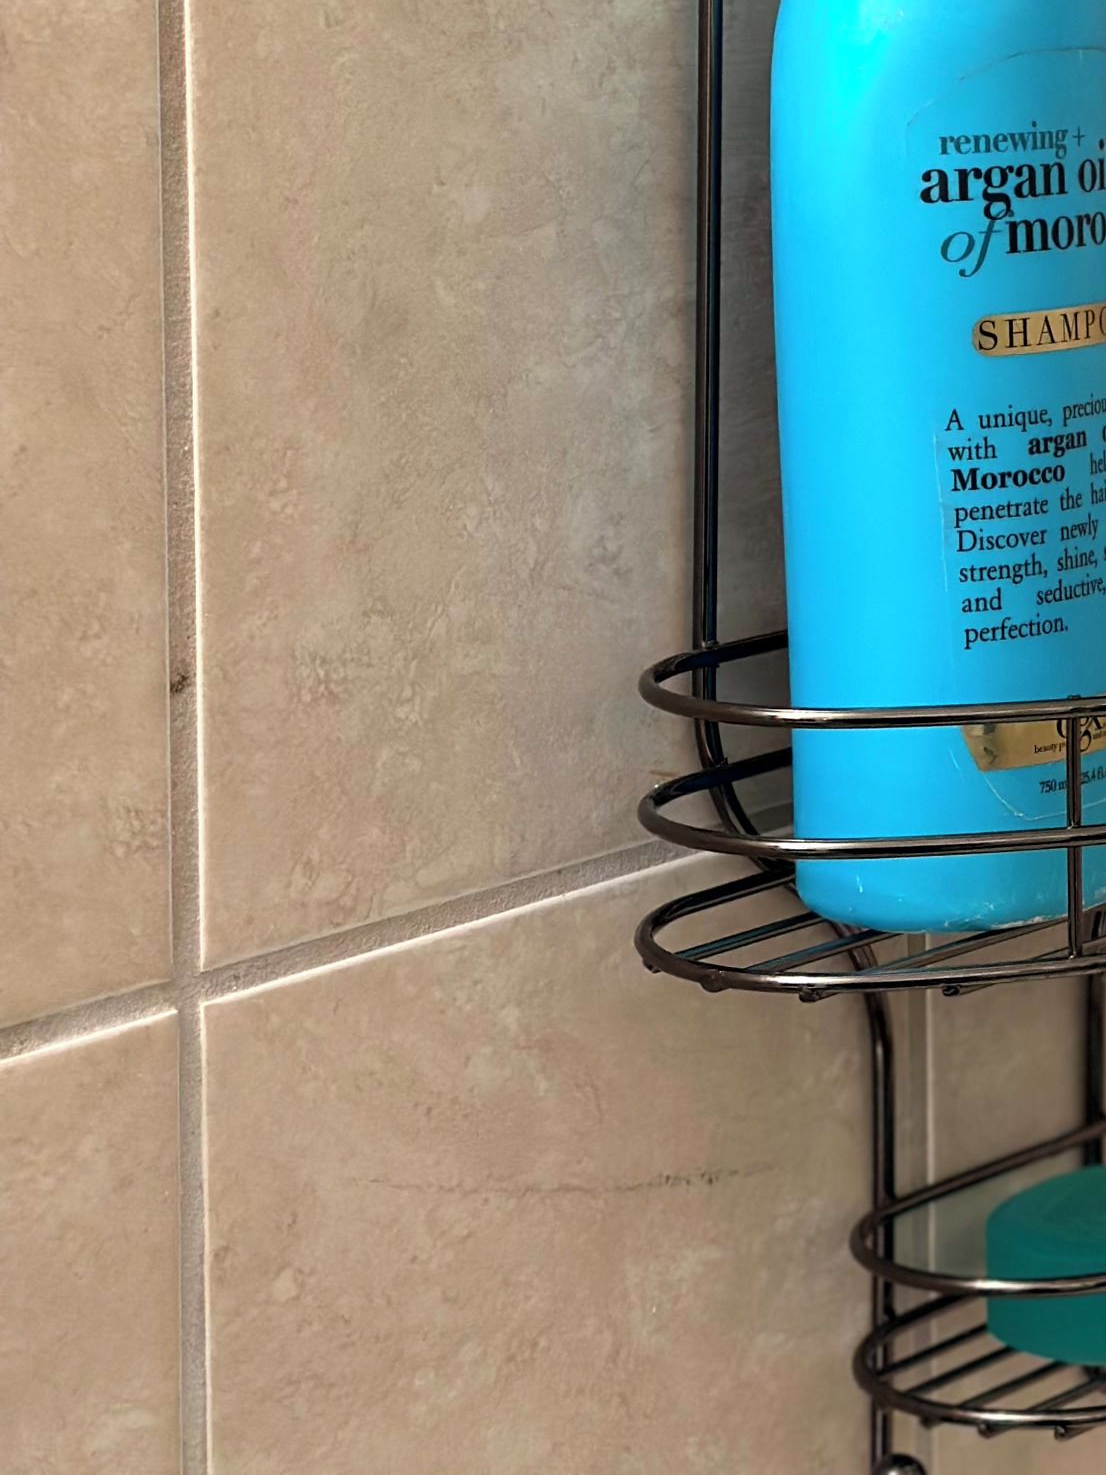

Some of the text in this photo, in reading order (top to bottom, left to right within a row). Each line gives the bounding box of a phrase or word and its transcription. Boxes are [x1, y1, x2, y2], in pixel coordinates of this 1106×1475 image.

[939, 121, 1069, 160] renewing
[919, 158, 1068, 221] argan
[940, 209, 1015, 278] of
[945, 408, 964, 432] A
[978, 404, 1053, 433] unique,
[948, 436, 998, 462] with
[1028, 430, 1087, 458] argan
[951, 464, 1066, 492] Morocco
[954, 498, 1049, 529] penetrate
[1059, 488, 1082, 512] the
[957, 528, 1048, 553] Discover
[1060, 512, 1099, 542] newly
[959, 553, 1048, 585] strength,
[1057, 546, 1098, 573] shine,
[961, 588, 1003, 614] and
[1036, 573, 1106, 606] seductive,
[964, 613, 1069, 650] perfection.
